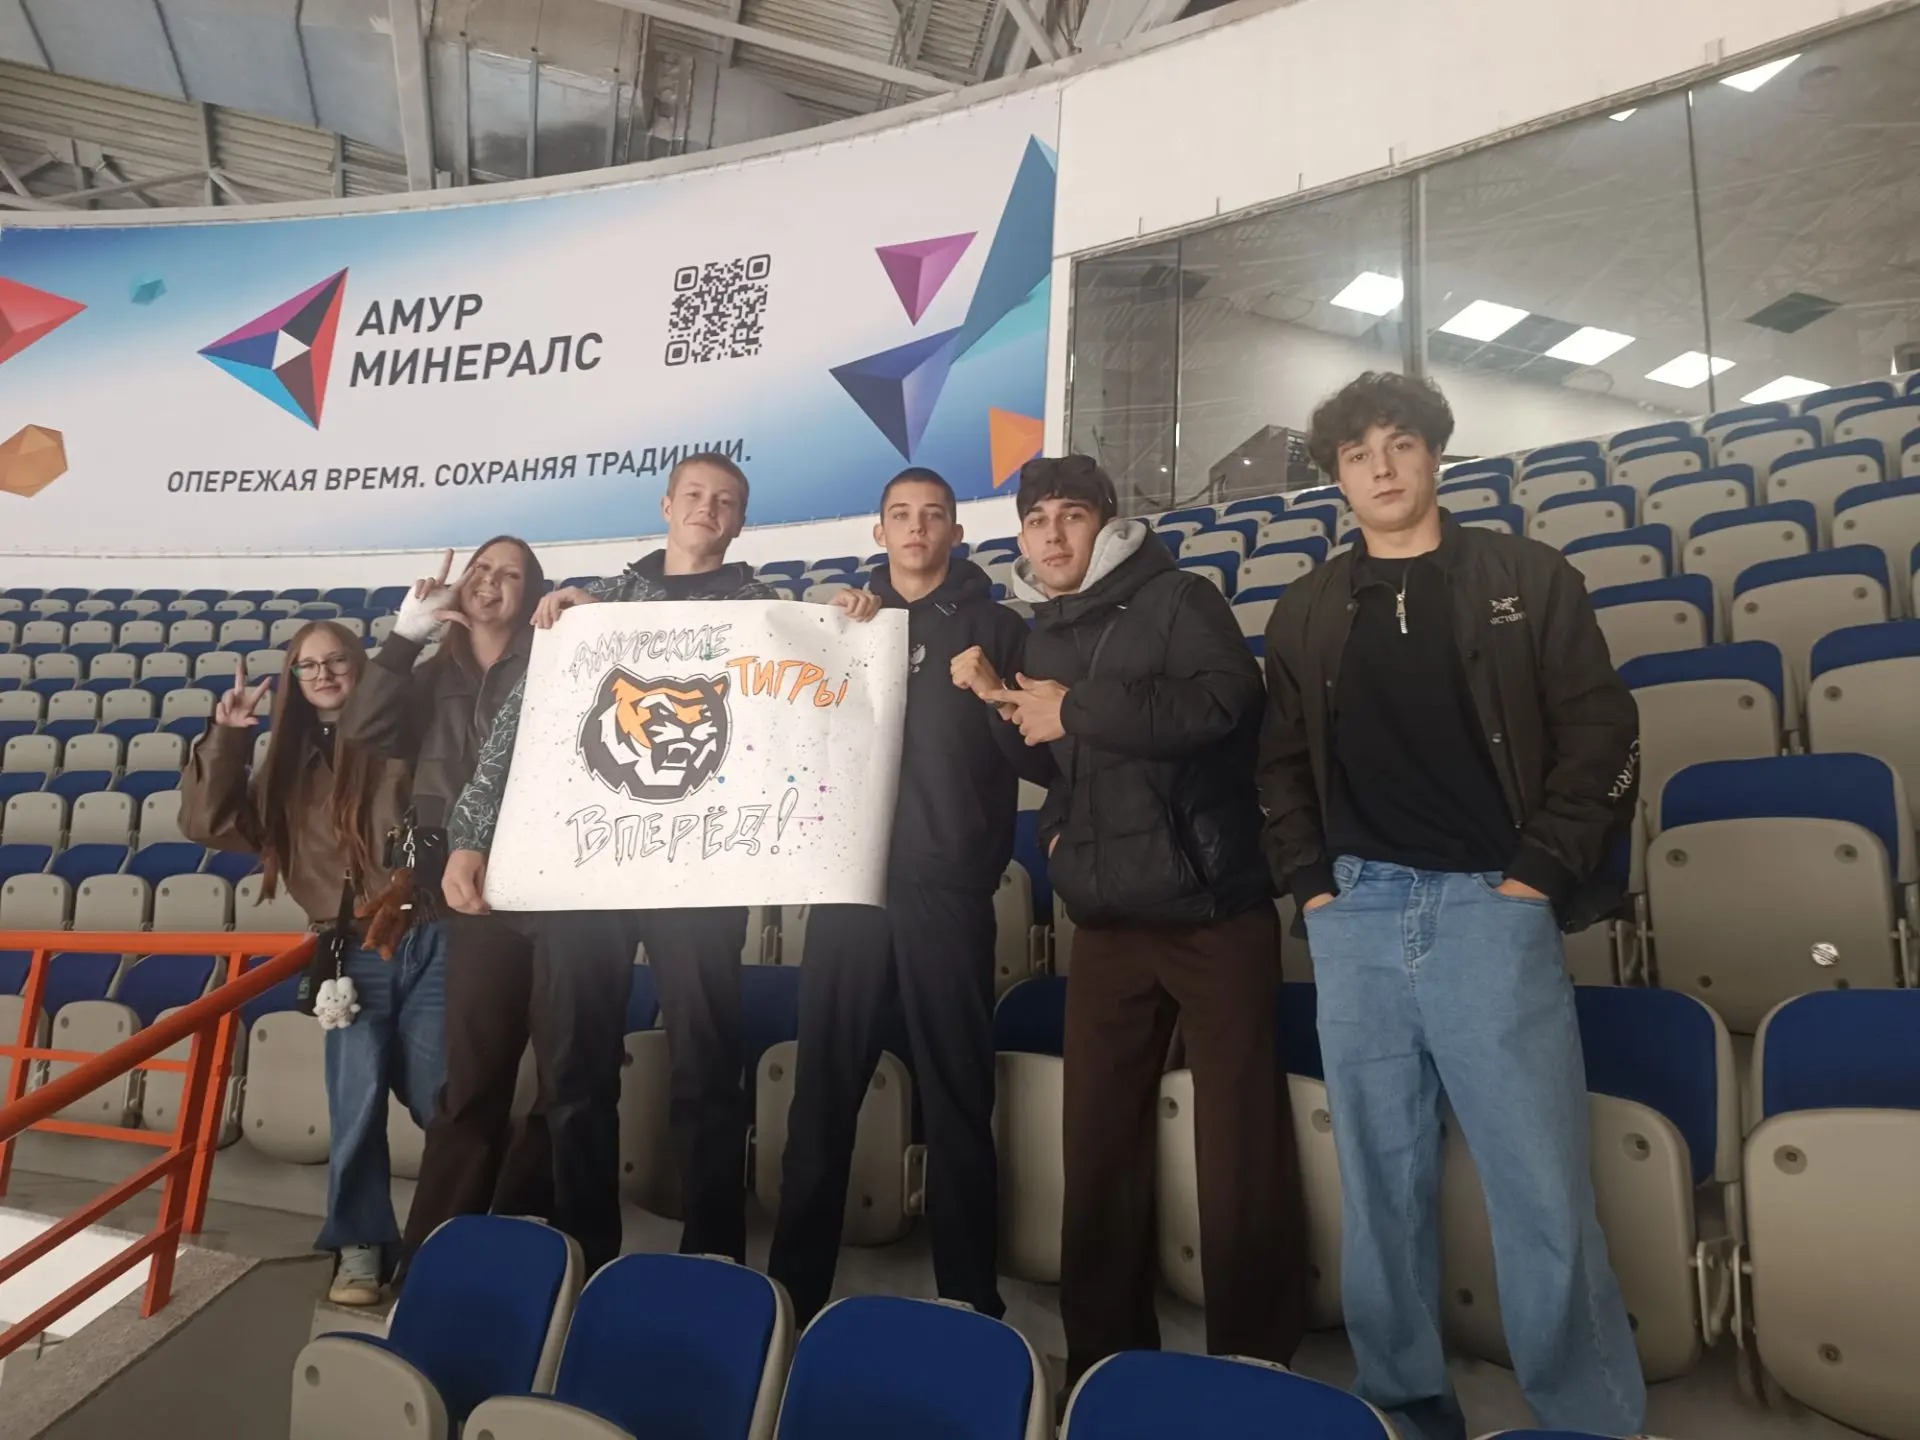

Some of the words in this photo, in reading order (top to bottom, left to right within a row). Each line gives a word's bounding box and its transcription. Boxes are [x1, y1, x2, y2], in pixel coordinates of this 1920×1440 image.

[355, 293, 483, 337] АМУР
[349, 332, 603, 388] МИНЕРАЛС
[167, 468, 318, 493] ОПЕРЕЖАЯ
[324, 465, 425, 491] ВРЕМЯ.
[434, 454, 577, 487] СОХРАНЯЯ
[571, 623, 733, 683] АМУРСКИЕ
[725, 655, 849, 708] ТИГРЫ
